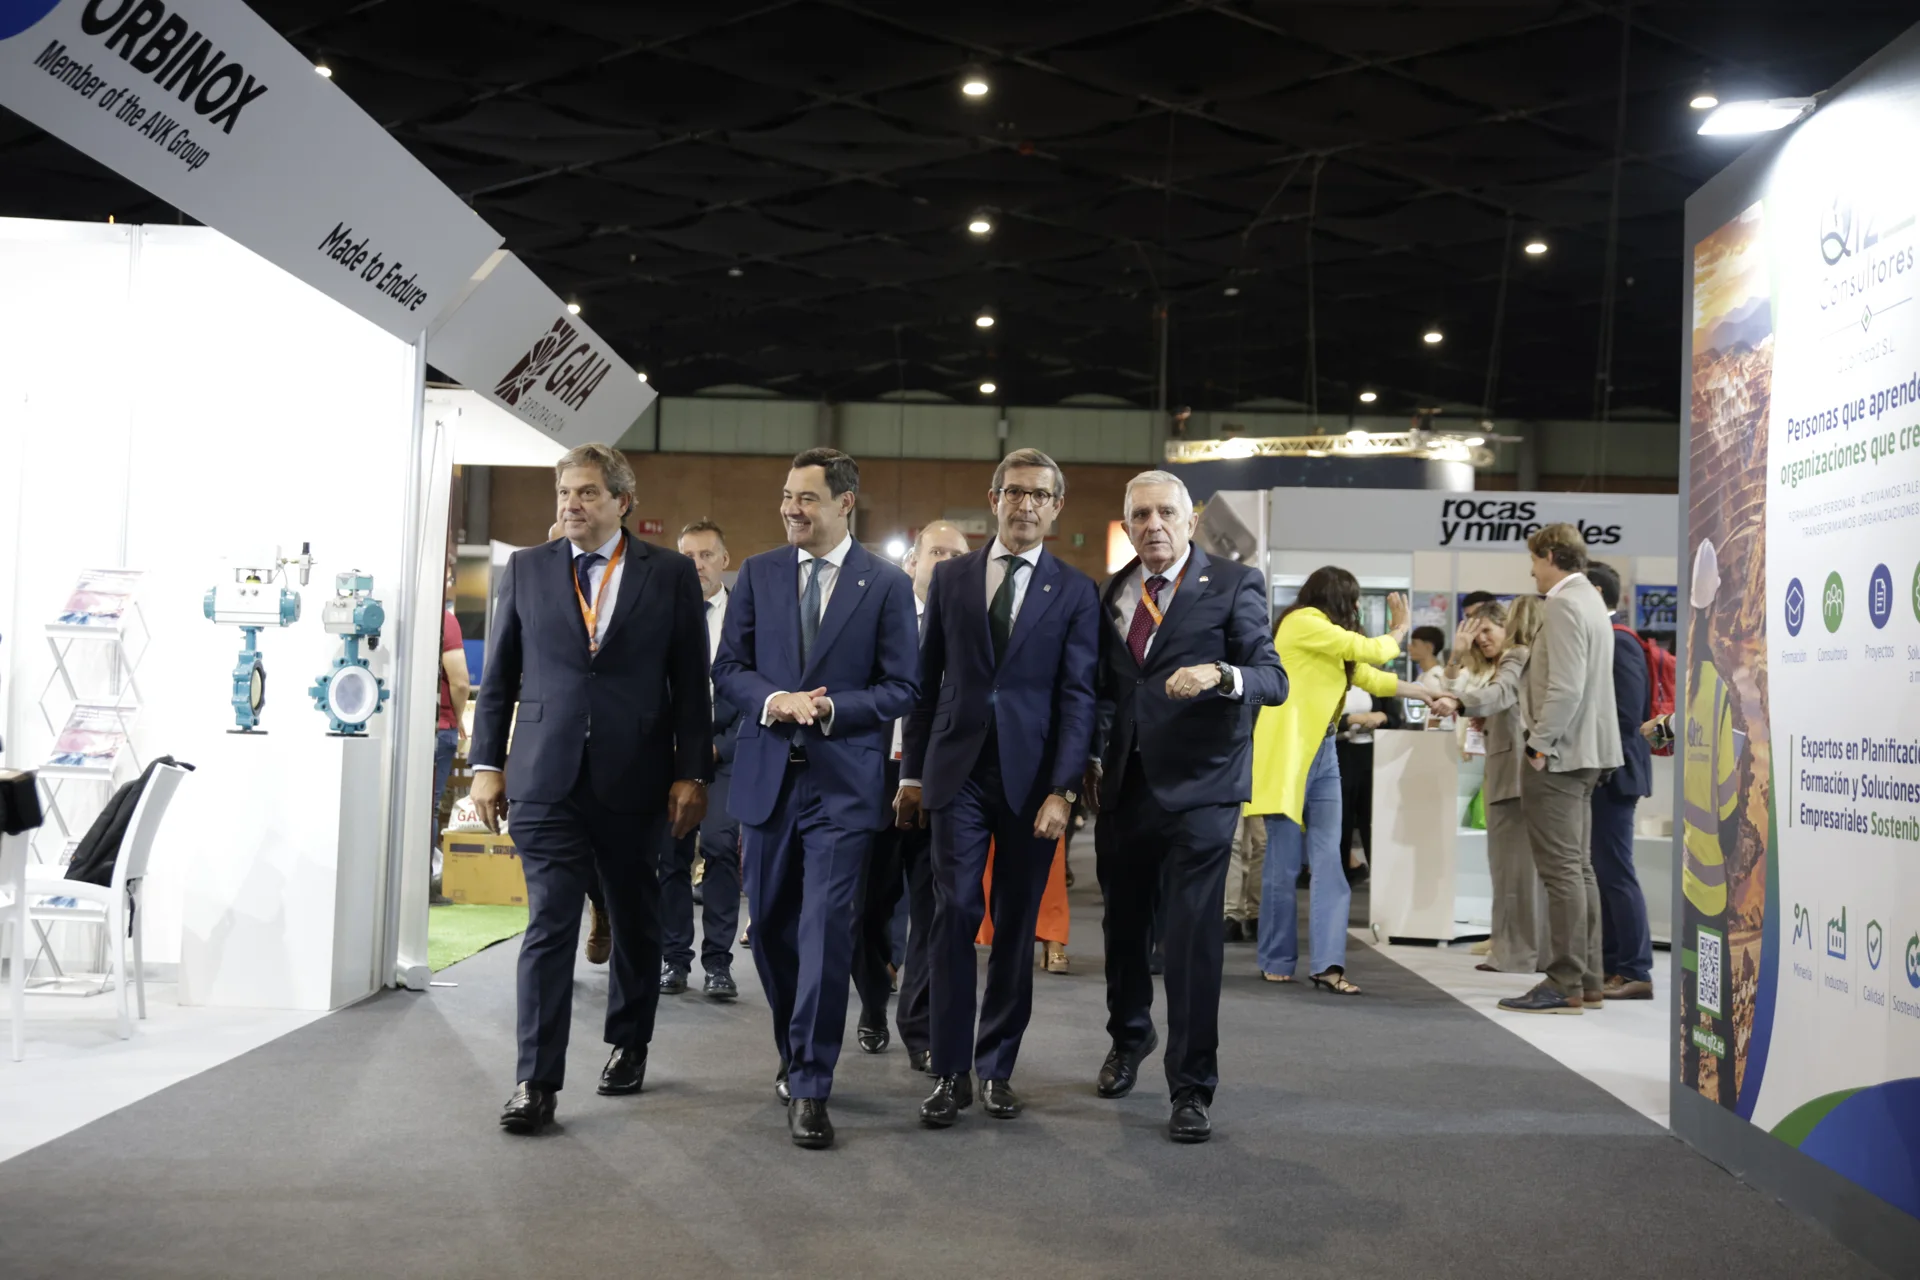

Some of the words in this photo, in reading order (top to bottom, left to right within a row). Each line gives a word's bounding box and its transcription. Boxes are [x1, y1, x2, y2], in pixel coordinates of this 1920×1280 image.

[81, 0, 268, 135] ORBINOX
[33, 40, 107, 100] Member
[98, 88, 129, 111] of
[115, 94, 147, 127] the
[138, 111, 179, 146] AVK
[167, 129, 210, 172] Group
[318, 221, 369, 271] Made
[360, 252, 384, 282] to
[375, 262, 427, 311] Endure
[545, 342, 612, 412] GAIA
[1787, 407, 1839, 444] Personas
[1842, 397, 1865, 431] que
[1780, 442, 1867, 488] organizaciones
[1871, 432, 1895, 466] que
[1900, 424, 1920, 451] cre
[1442, 499, 1536, 520] rocas
[1824, 496, 1855, 514] PERSONAS
[1861, 484, 1900, 504] ACTIVAMOS
[1858, 502, 1920, 526] ORGANIZACIONES
[1439, 520, 1460, 546] y
[1464, 519, 1621, 545] mineles
[1865, 643, 1894, 662] Proyectos
[1801, 735, 1843, 763] Expertos
[1846, 741, 1858, 760] en
[1801, 768, 1849, 796] Formación
[1852, 778, 1858, 802] y
[1862, 773, 1920, 803] Soluciones
[1800, 802, 1868, 834] Empresariales
[1871, 810, 1920, 842] Sostenib
[1864, 985, 1884, 1006] Calidad
